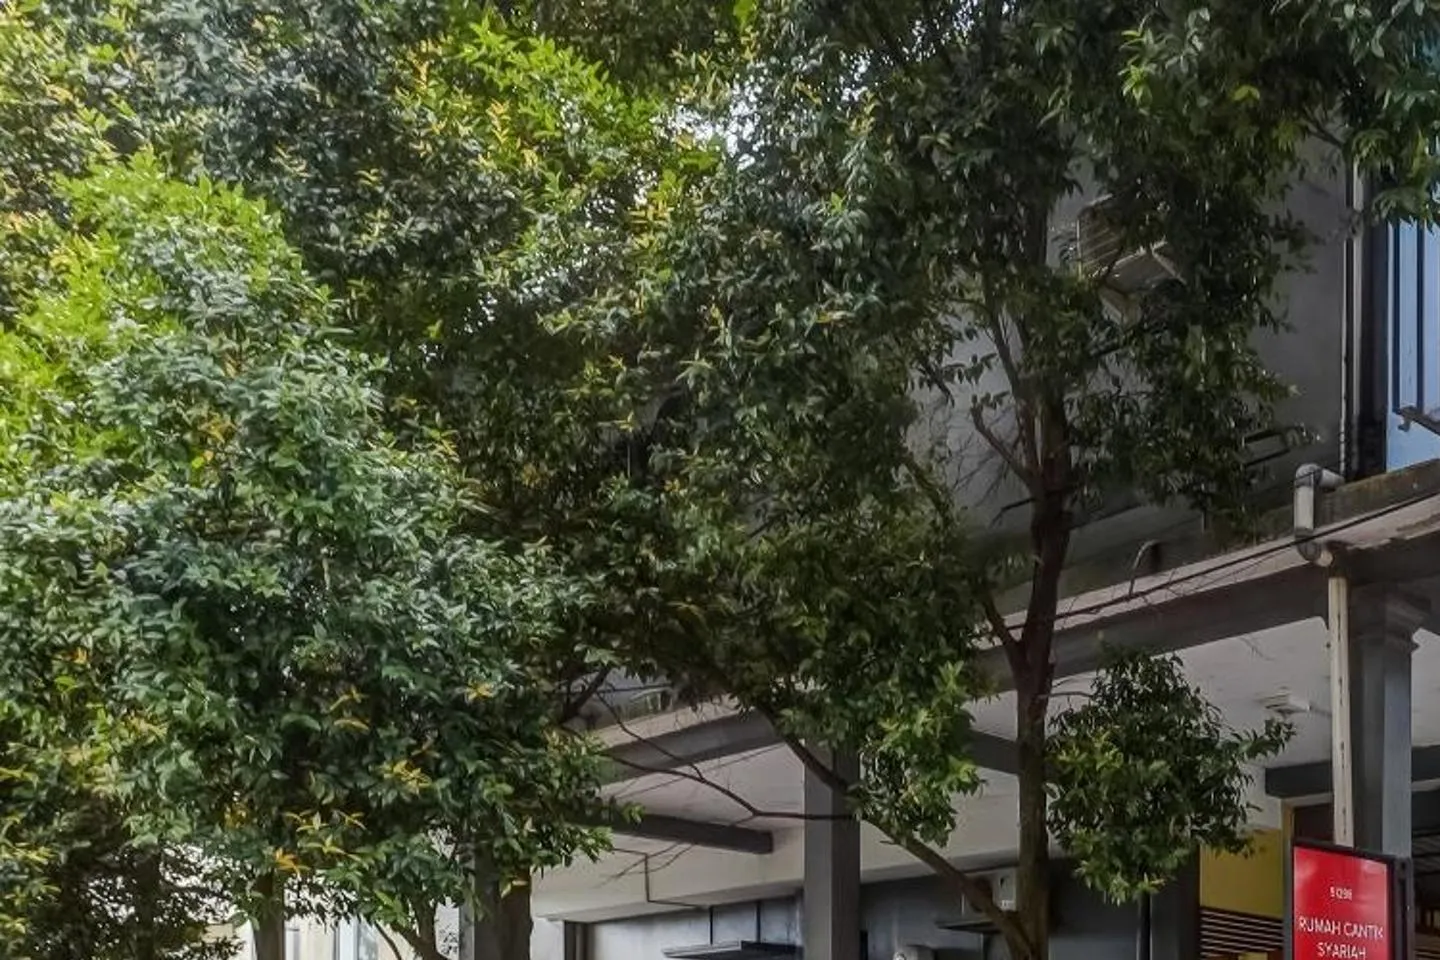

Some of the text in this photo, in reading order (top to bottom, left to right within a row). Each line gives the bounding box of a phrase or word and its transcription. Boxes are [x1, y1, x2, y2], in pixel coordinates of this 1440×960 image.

[1299, 916, 1384, 941] RUMAH CANTIK
[1316, 941, 1366, 960] SYARIAH
